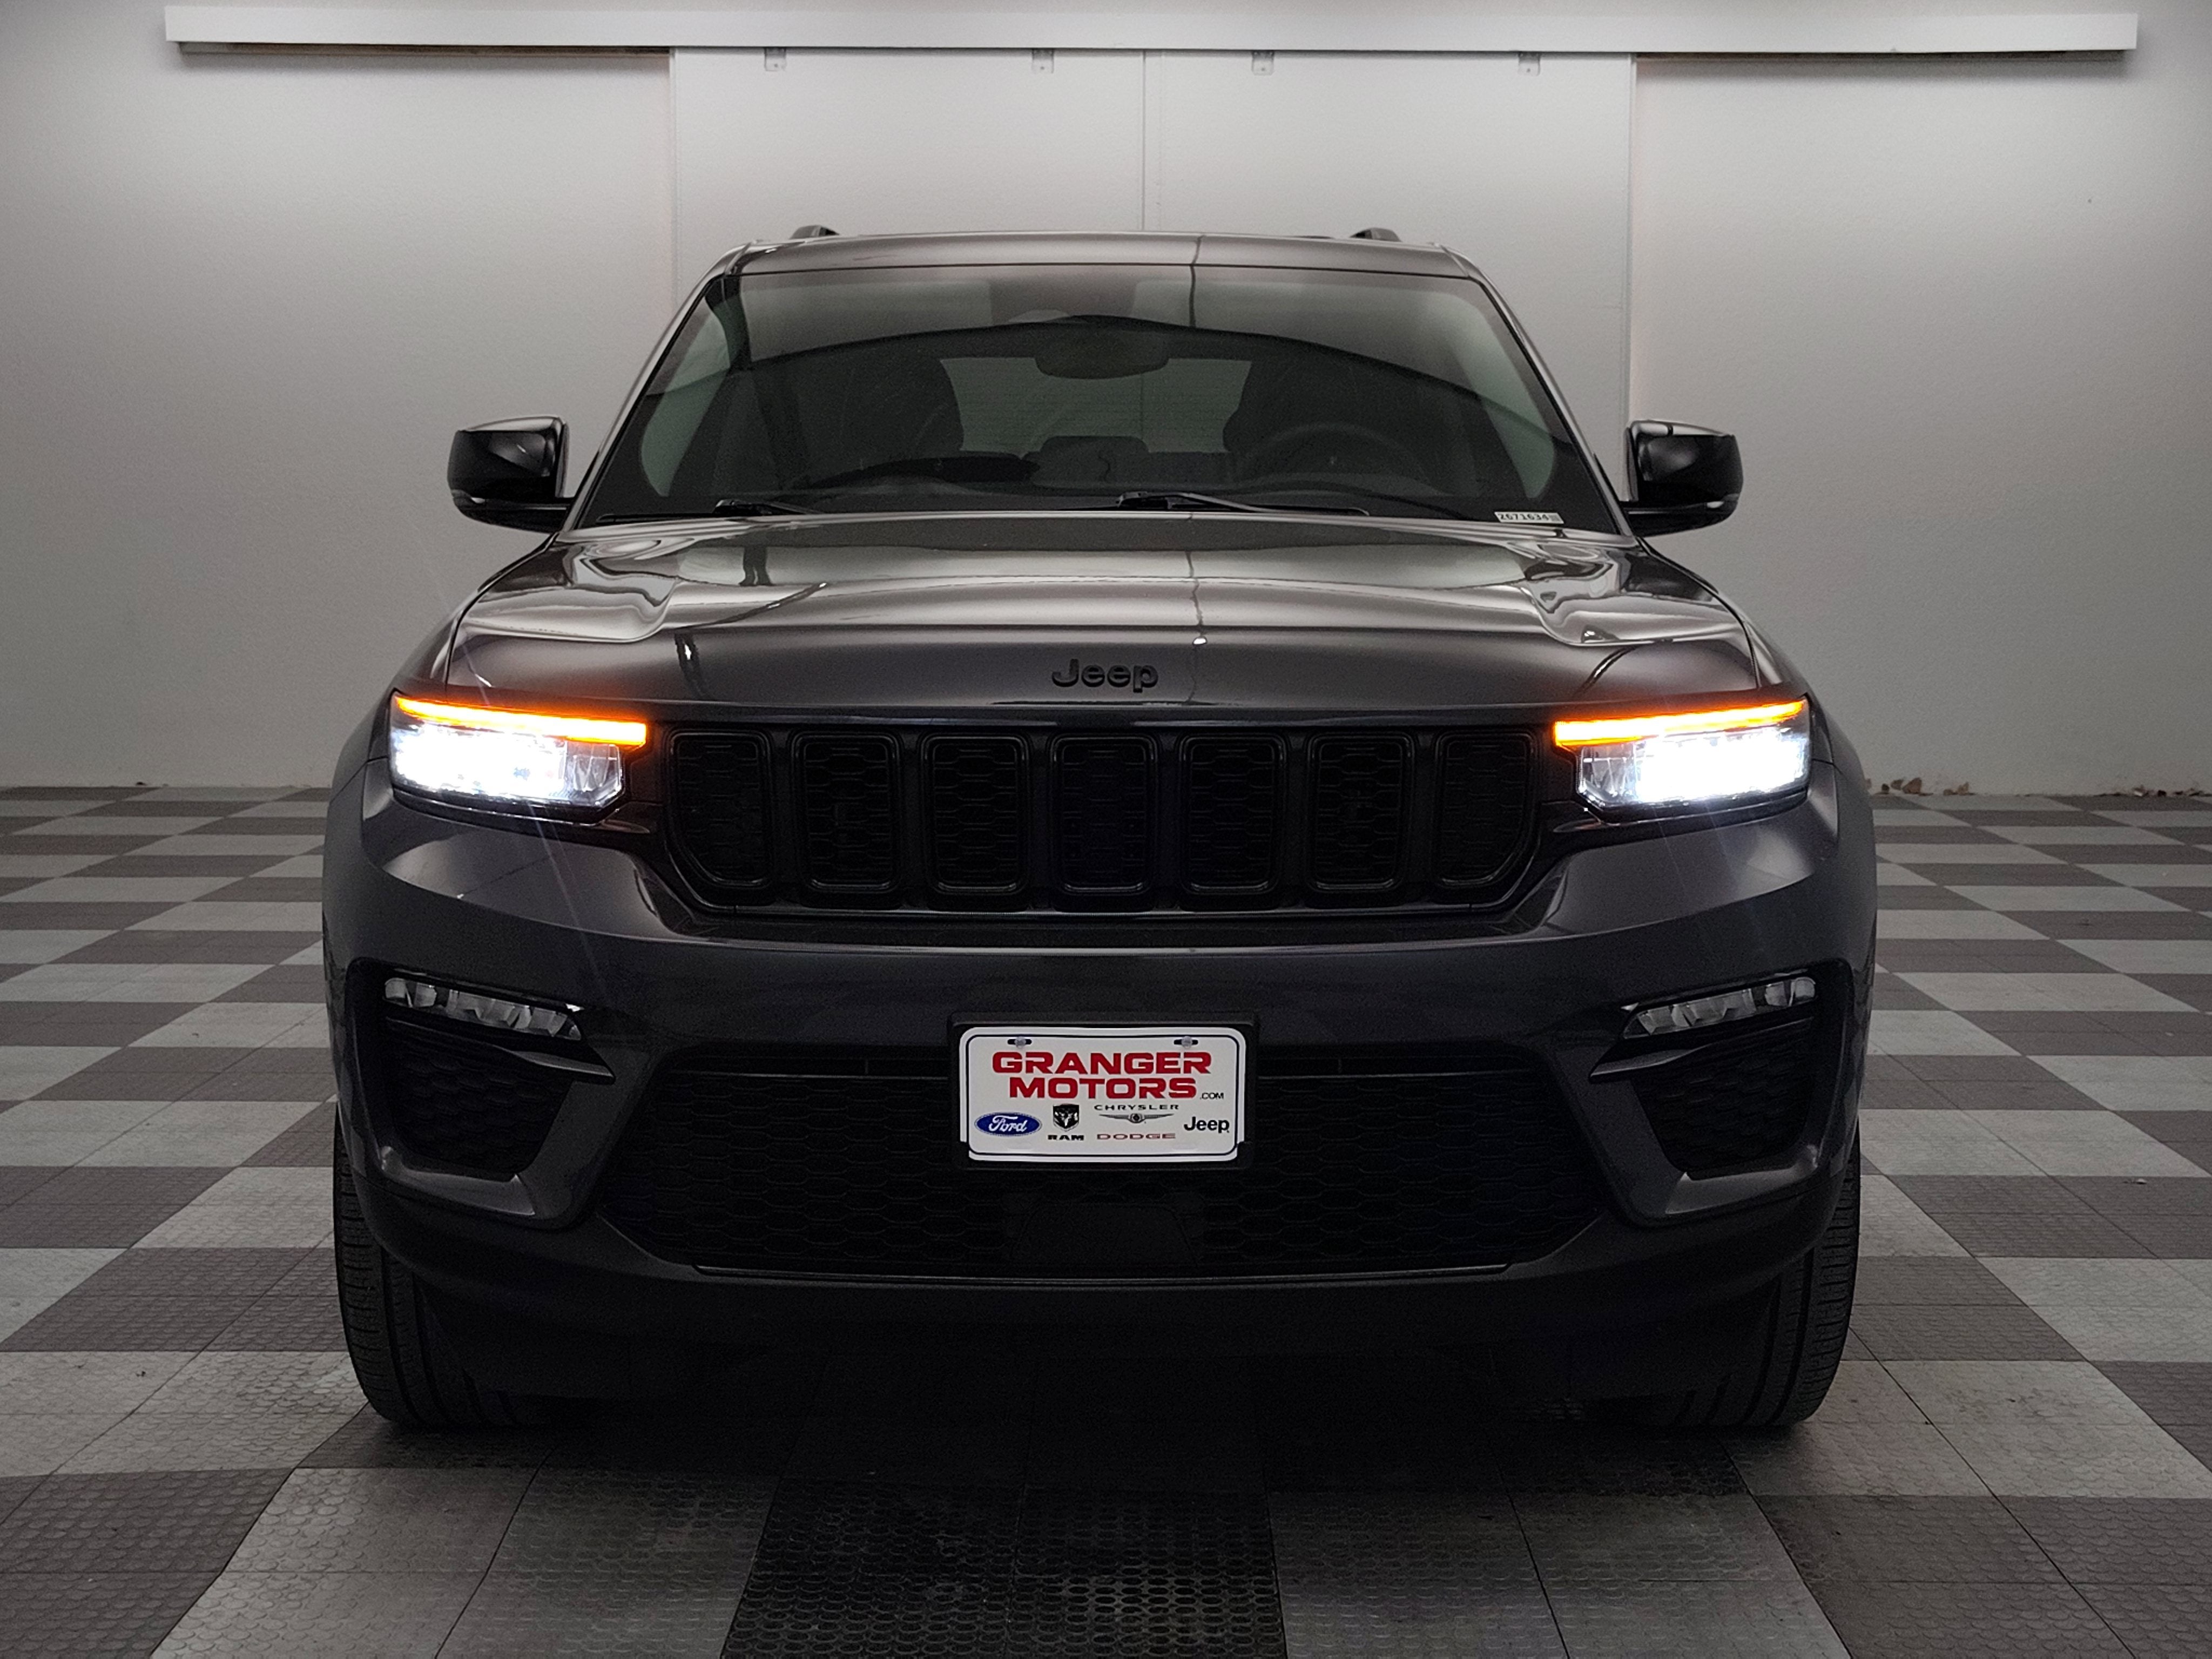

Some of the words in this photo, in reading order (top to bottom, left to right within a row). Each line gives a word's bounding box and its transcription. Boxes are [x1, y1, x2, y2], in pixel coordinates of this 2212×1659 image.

[1052, 658, 1158, 693] Jeep
[992, 1051, 1212, 1075] GRANGER
[1009, 1077, 1197, 1099] MOTORS
[1199, 1092, 1224, 1100] .COM
[988, 1115, 1027, 1132] Ford
[1184, 1116, 1229, 1133] Jeep
